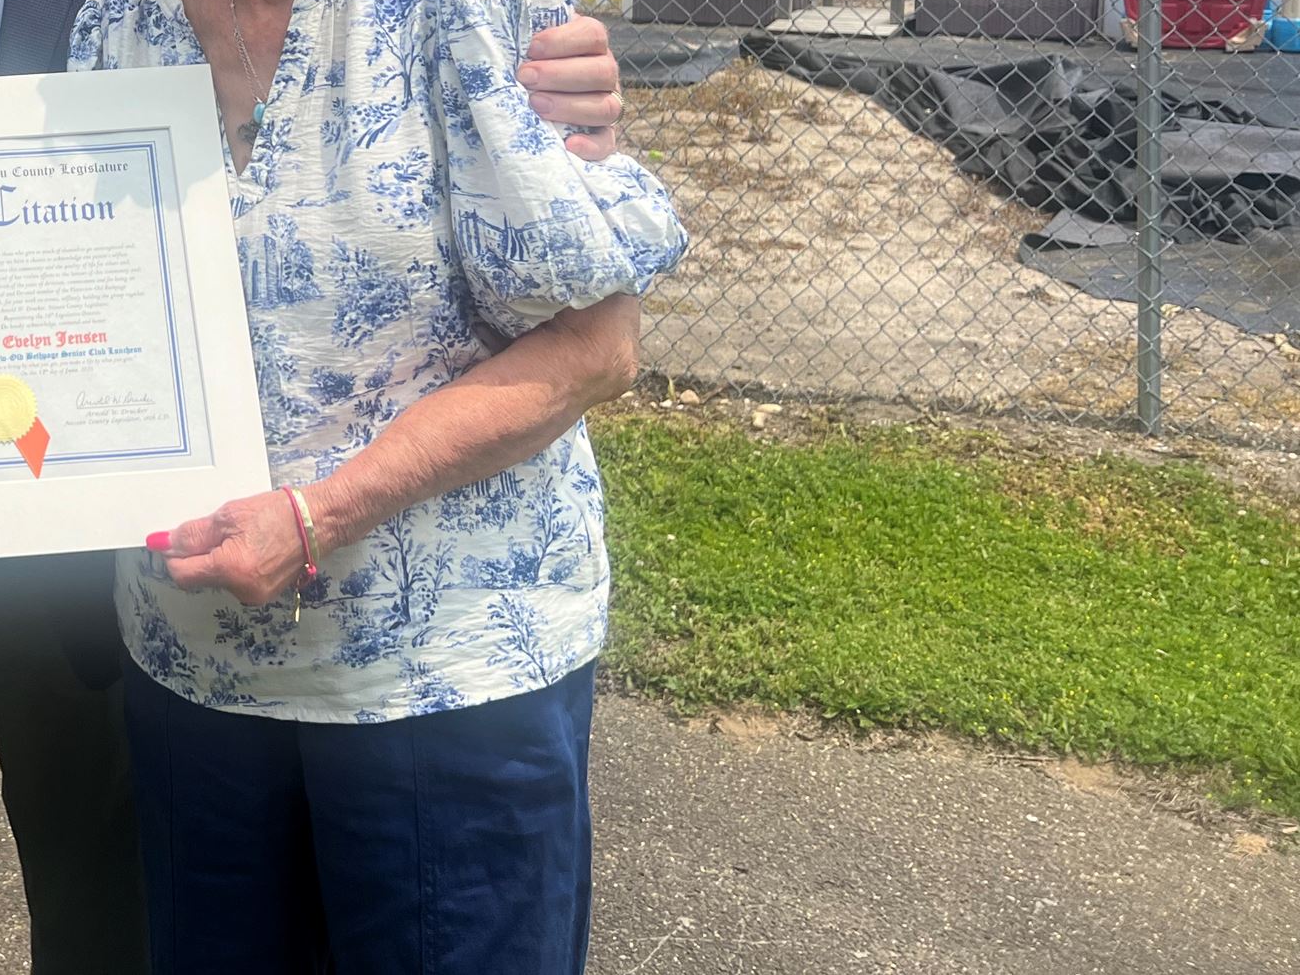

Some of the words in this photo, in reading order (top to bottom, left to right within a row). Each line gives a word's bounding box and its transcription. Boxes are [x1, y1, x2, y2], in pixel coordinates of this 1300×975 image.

[12, 166, 55, 177] County
[60, 161, 129, 176] Legislature
[2, 334, 51, 349] Evelyn
[55, 331, 107, 348] Jensen
[61, 350, 86, 358] Senior
[88, 348, 106, 356] Club
[108, 346, 142, 355] Luncheon
